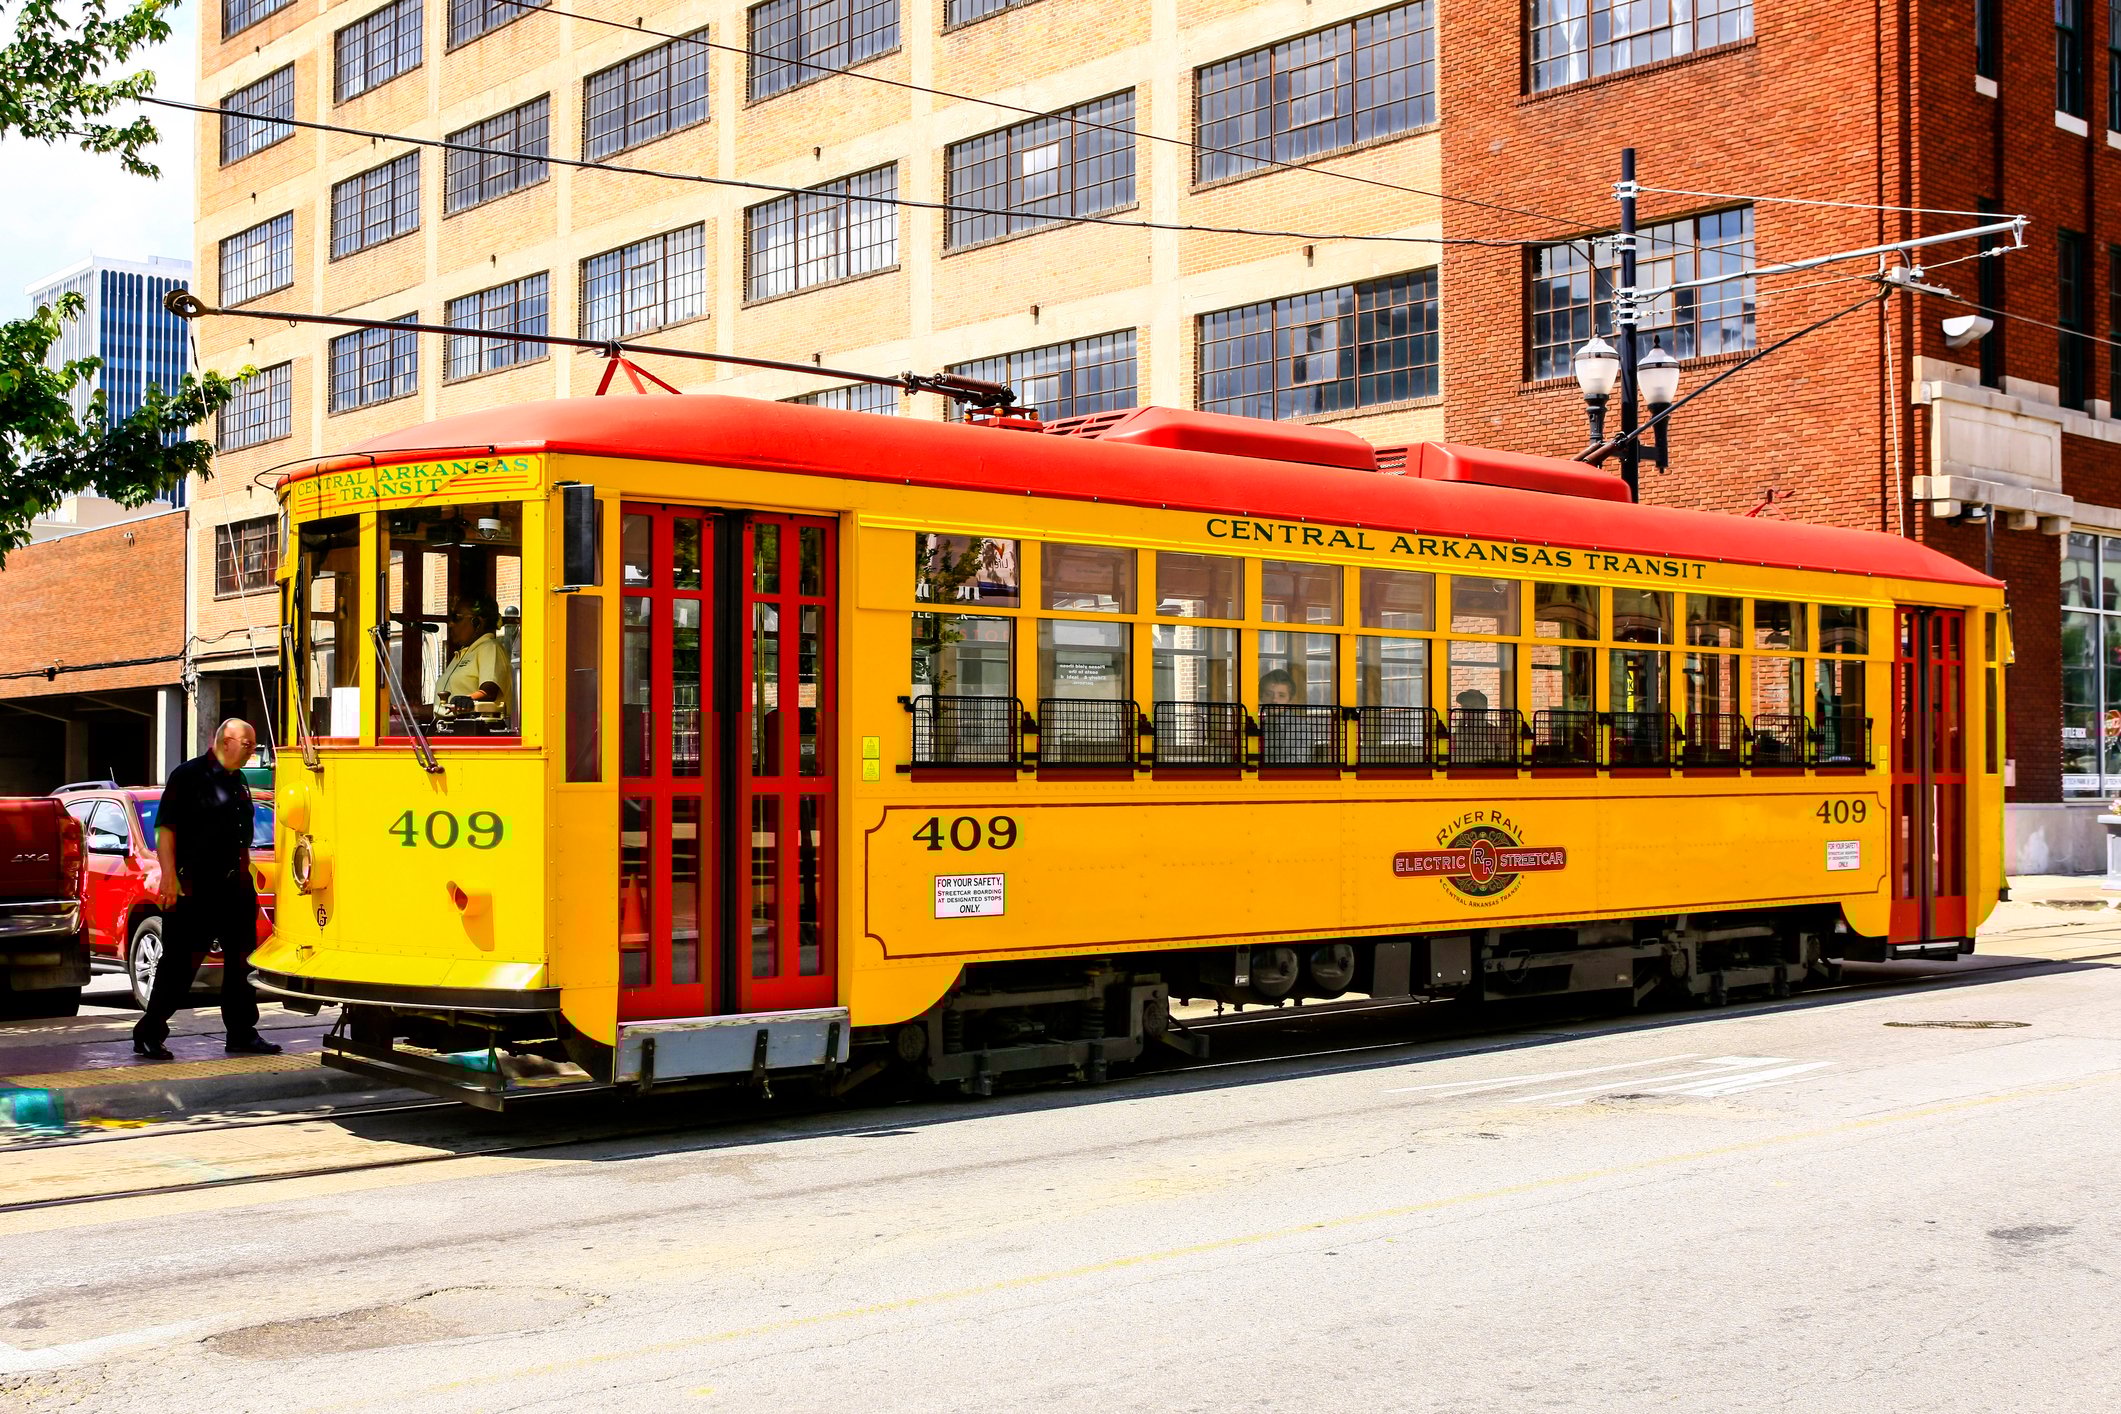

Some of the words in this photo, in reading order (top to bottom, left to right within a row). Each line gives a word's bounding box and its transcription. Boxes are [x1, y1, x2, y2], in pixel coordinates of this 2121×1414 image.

[298, 472, 368, 496] CENTRAL
[378, 457, 529, 482] ARKANSAS
[340, 478, 443, 501] TRANSIT
[1206, 518, 1375, 550] CENTRAL
[1390, 536, 1572, 568] ARKANSAS
[1584, 553, 1707, 579] TRANSIT
[1816, 799, 1866, 824] 409
[388, 809, 504, 850] 409
[912, 815, 1017, 851] 409
[1436, 811, 1484, 846] RIVER
[1491, 810, 1525, 844] RAIL
[1396, 855, 1466, 872] ELECTRIC
[1500, 851, 1564, 867] STREETCAR
[937, 878, 952, 888] FOR
[953, 878, 972, 887] YOUR
[1442, 882, 1467, 905] CENTRAL
[1469, 900, 1500, 908] ARKANSAS
[1500, 881, 1523, 902] TRANSIT
